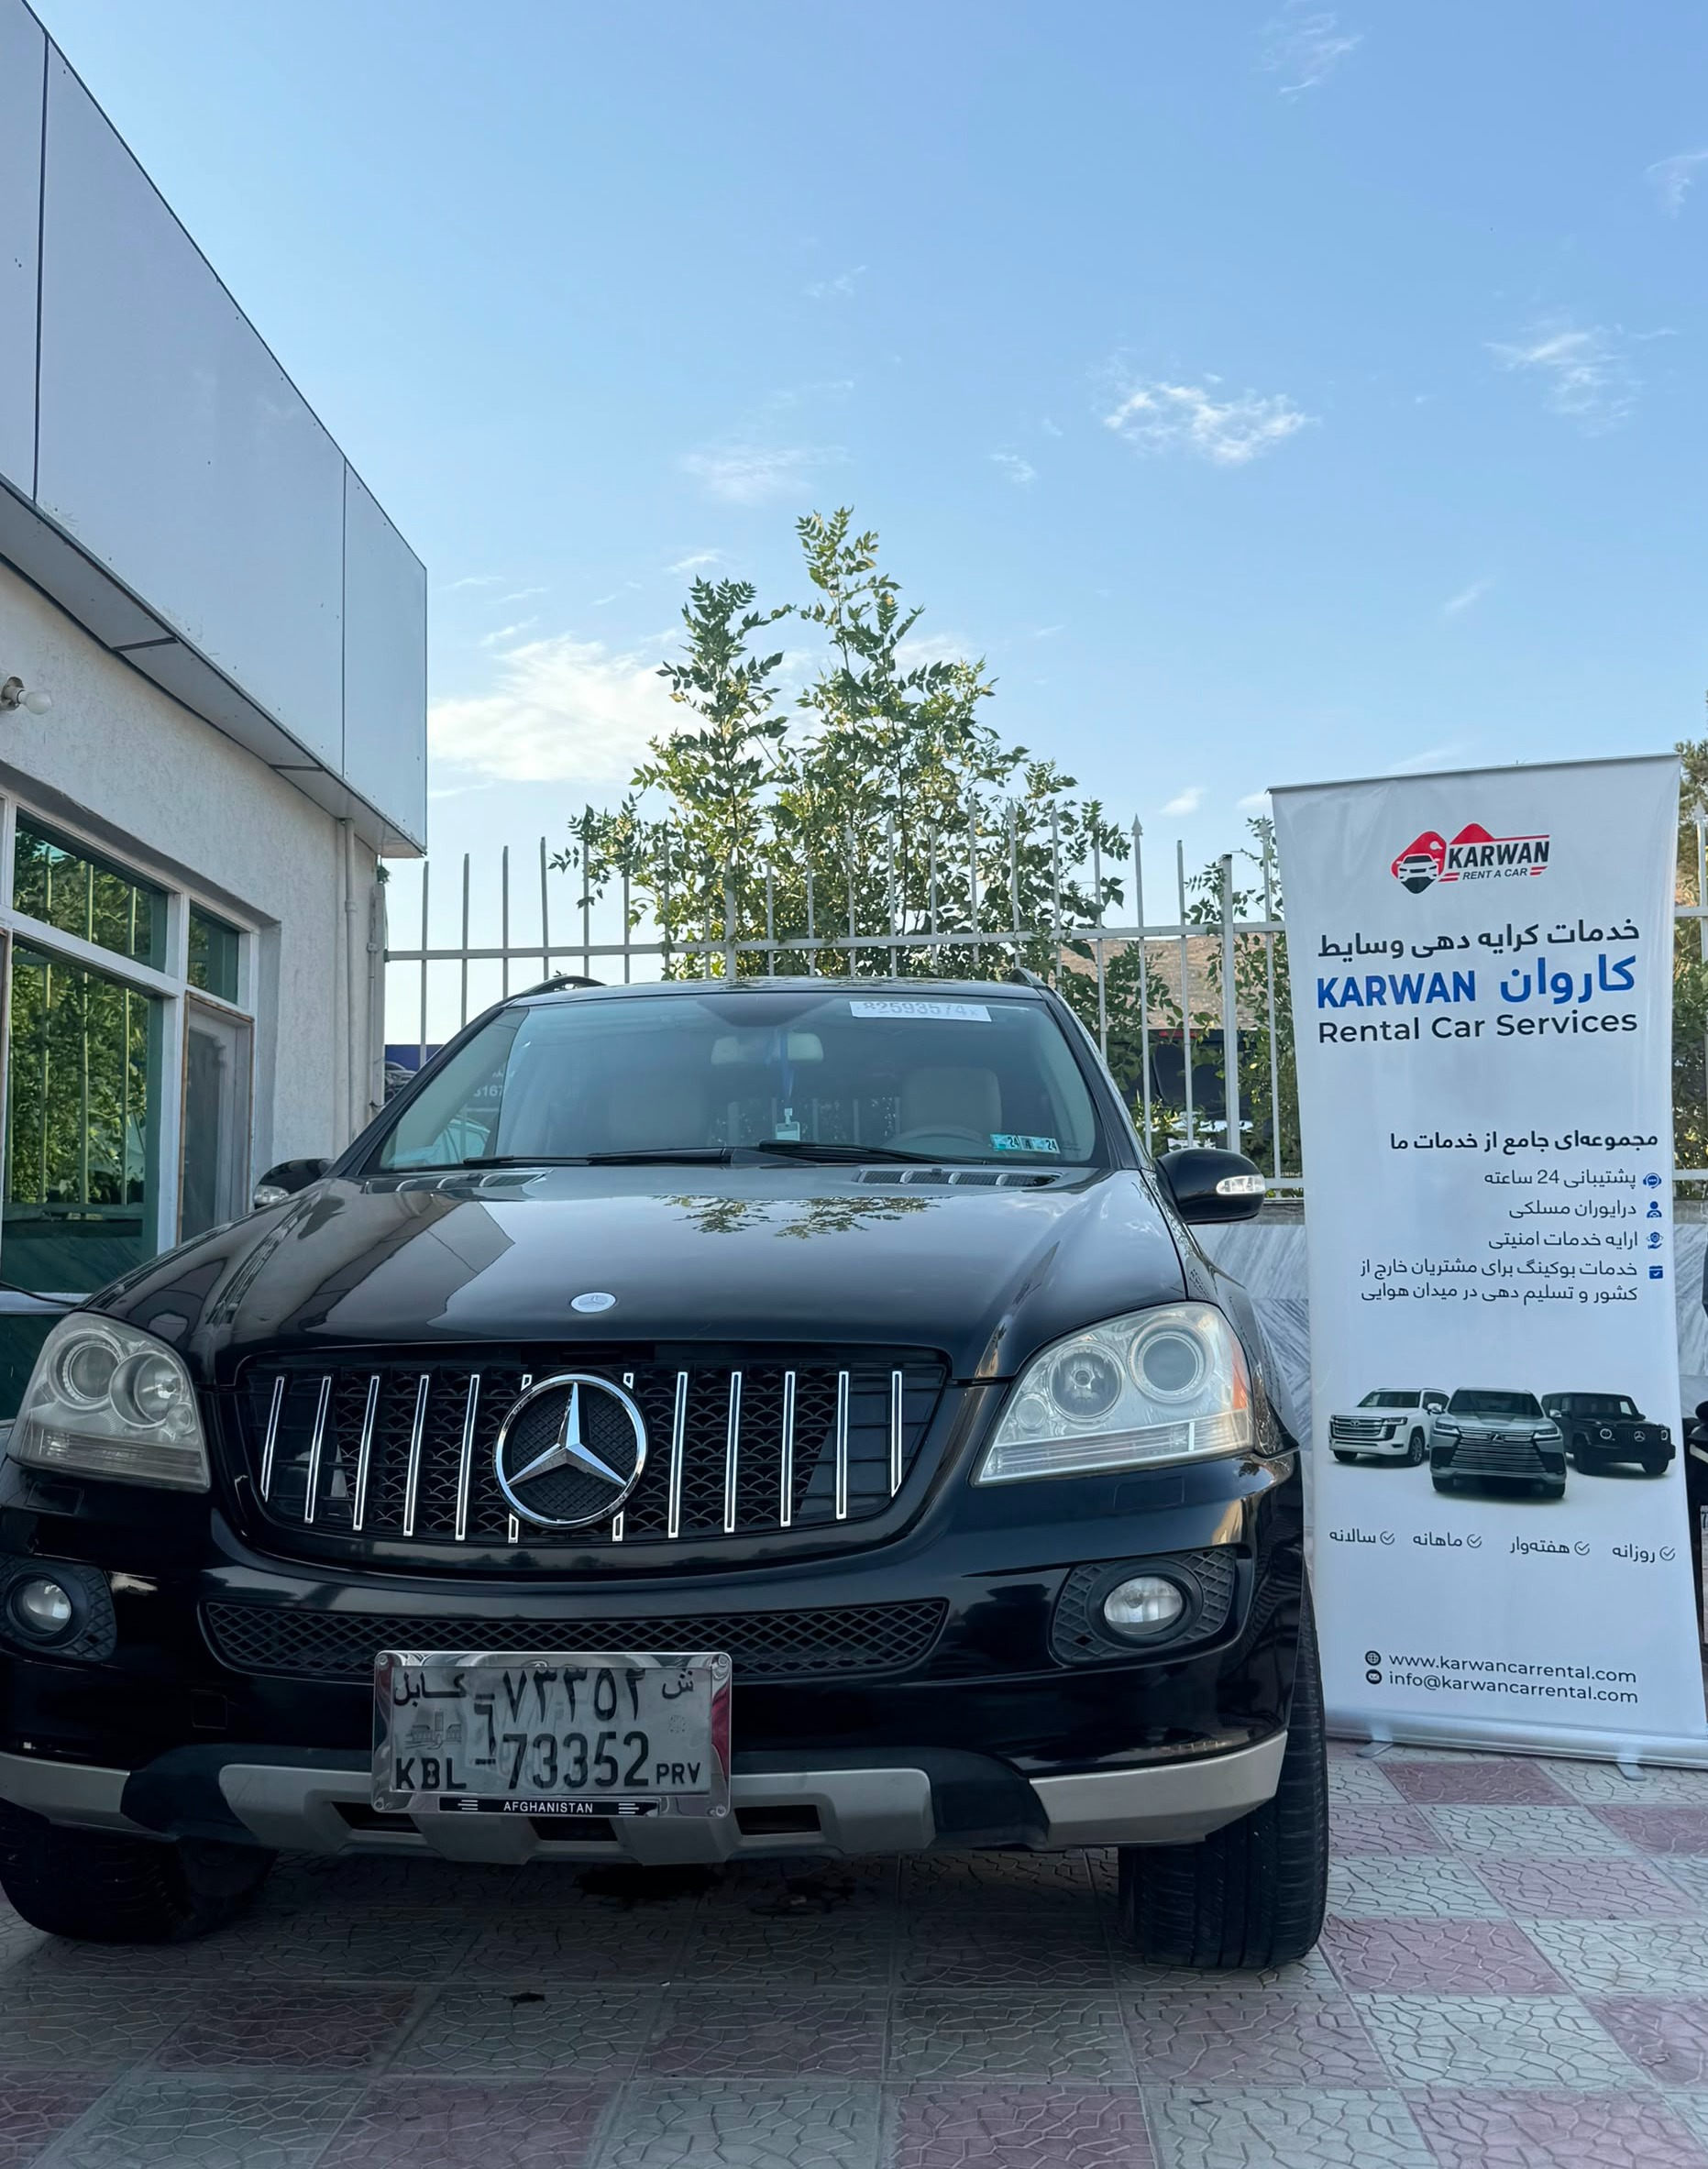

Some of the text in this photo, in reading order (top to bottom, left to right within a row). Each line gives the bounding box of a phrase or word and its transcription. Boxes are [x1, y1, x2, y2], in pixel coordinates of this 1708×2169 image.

[1448, 842, 1549, 869] KARWAN
[1462, 867, 1528, 880] RENT A CAR
[1317, 919, 1639, 963] خدمات کرایه دهی وسایط
[1317, 970, 1476, 1008] KARWAN
[1500, 953, 1636, 1005] کاروان
[1318, 1009, 1637, 1043] Rental Car Services
[1390, 1132, 1408, 1150] ما
[1414, 1131, 1478, 1149] خدمات
[1484, 1130, 1497, 1152] از
[1503, 1130, 1549, 1155] جامع
[1483, 1168, 1636, 1190] پشتیبانی 24 ساعته
[1509, 1199, 1636, 1219] درایوران مسلکی
[1488, 1230, 1638, 1250] ارایه خدمات امنیتی
[1360, 1258, 1638, 1281] خدمات بوکینگ برای مشتریان خارج از
[1361, 1282, 1638, 1306] کشور و تسلیم دهی در میدان هوایی
[1329, 1528, 1376, 1544] سالانه
[1413, 1532, 1463, 1547] ماهانه
[1612, 1543, 1656, 1564] روزانه
[1388, 1654, 1637, 1684] www.karwancarrental.com
[393, 1670, 467, 1708] کابل
[1389, 1670, 1639, 1704] info@karwancarrental.com
[396, 1731, 700, 1789] KBL 73352 PRV
[503, 1801, 593, 1813] AFGHANISTAN
